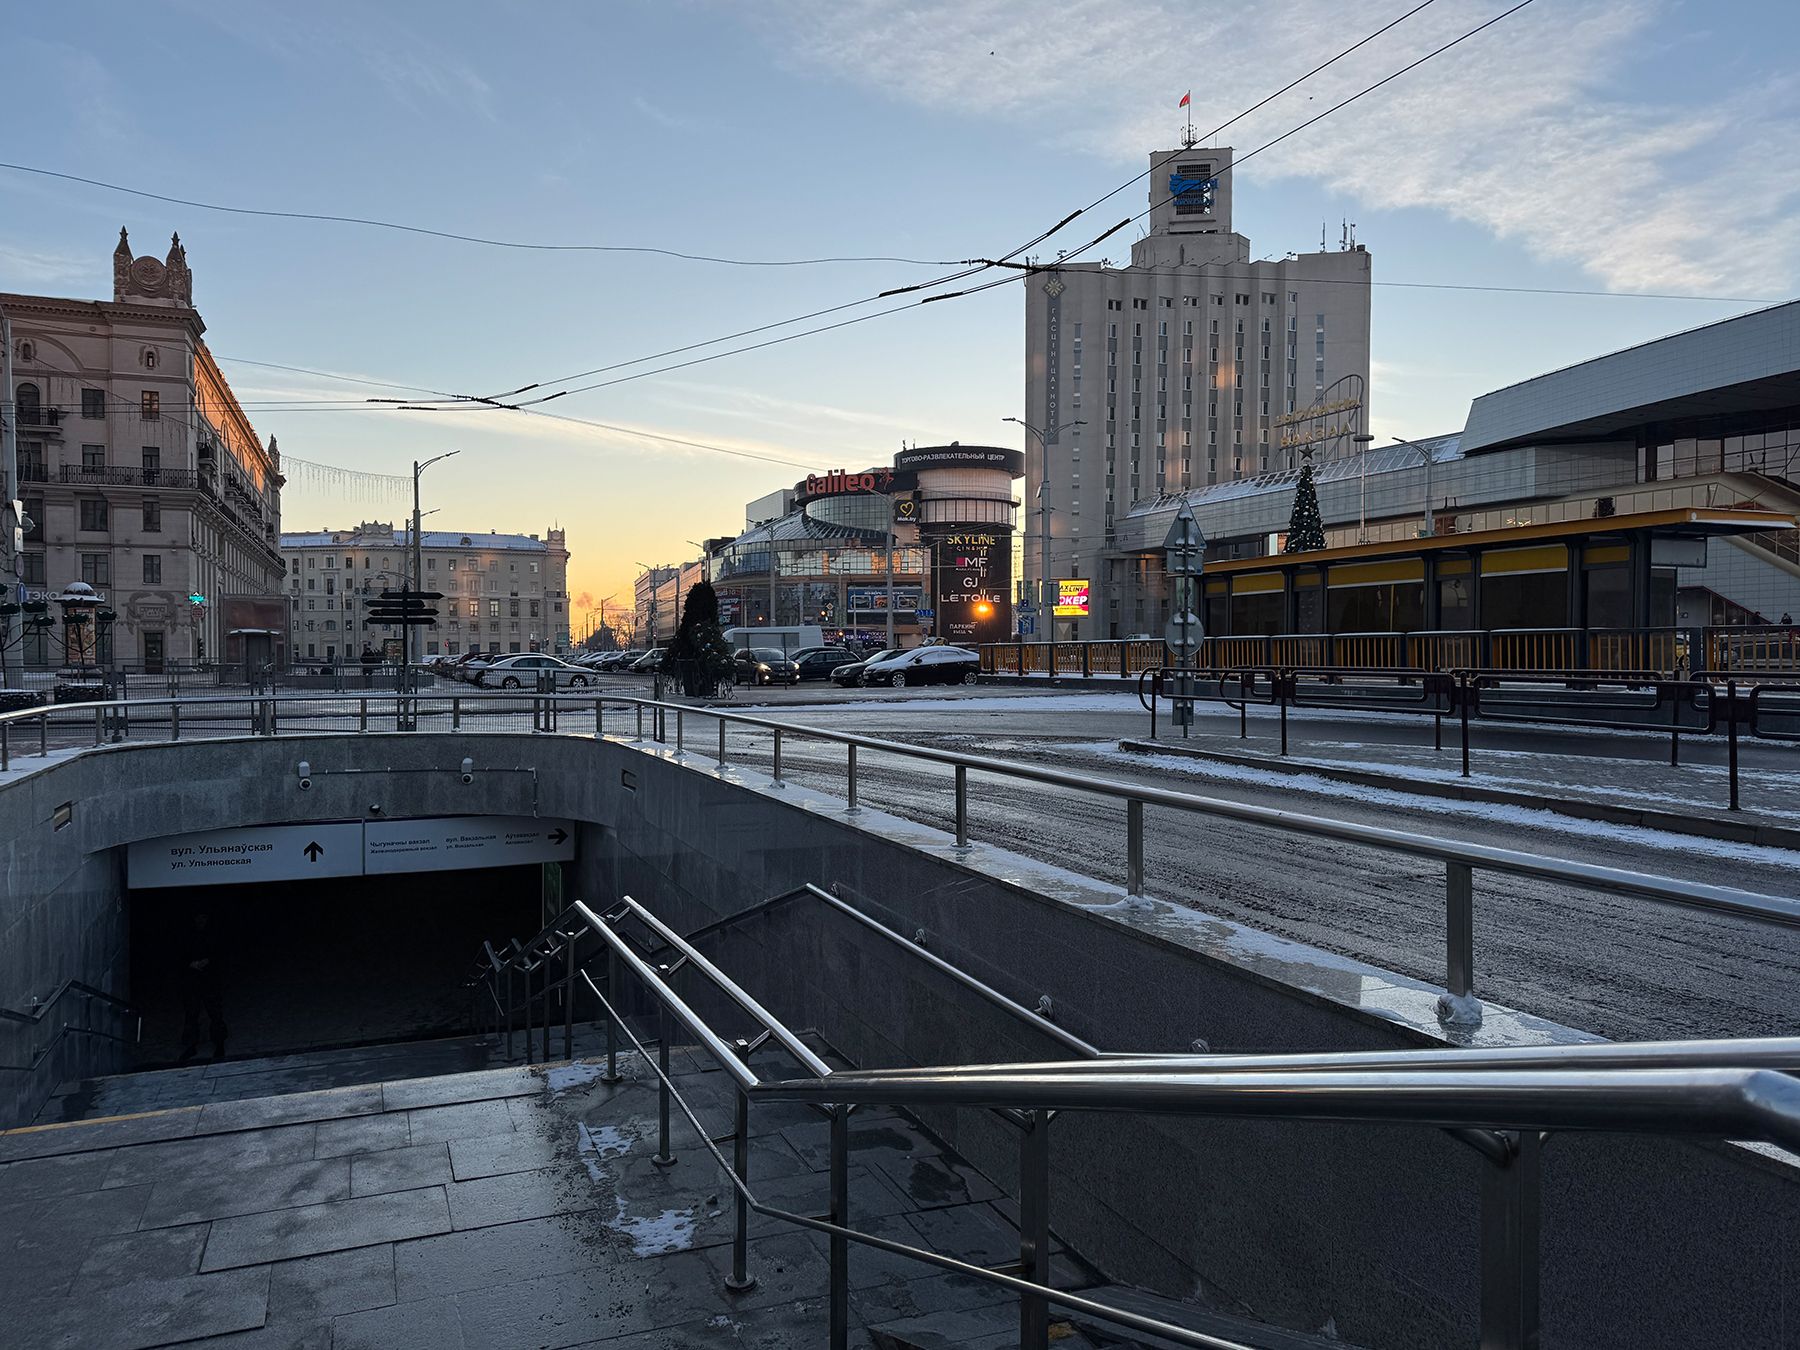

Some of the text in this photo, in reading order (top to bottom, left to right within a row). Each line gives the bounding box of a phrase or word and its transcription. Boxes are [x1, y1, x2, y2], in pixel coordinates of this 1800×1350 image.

[901, 453, 985, 464] ТОРГОВО-РАЗВЛЕКАТЕЛЬНЫЙ
[806, 469, 875, 495] Galileo
[947, 535, 996, 545] SKYLINE
[963, 577, 979, 588] GJ
[1059, 596, 1088, 605] ОКЕР
[171, 843, 273, 857] вул. Ульянаўская
[171, 858, 252, 870] ул. Ульяновская
